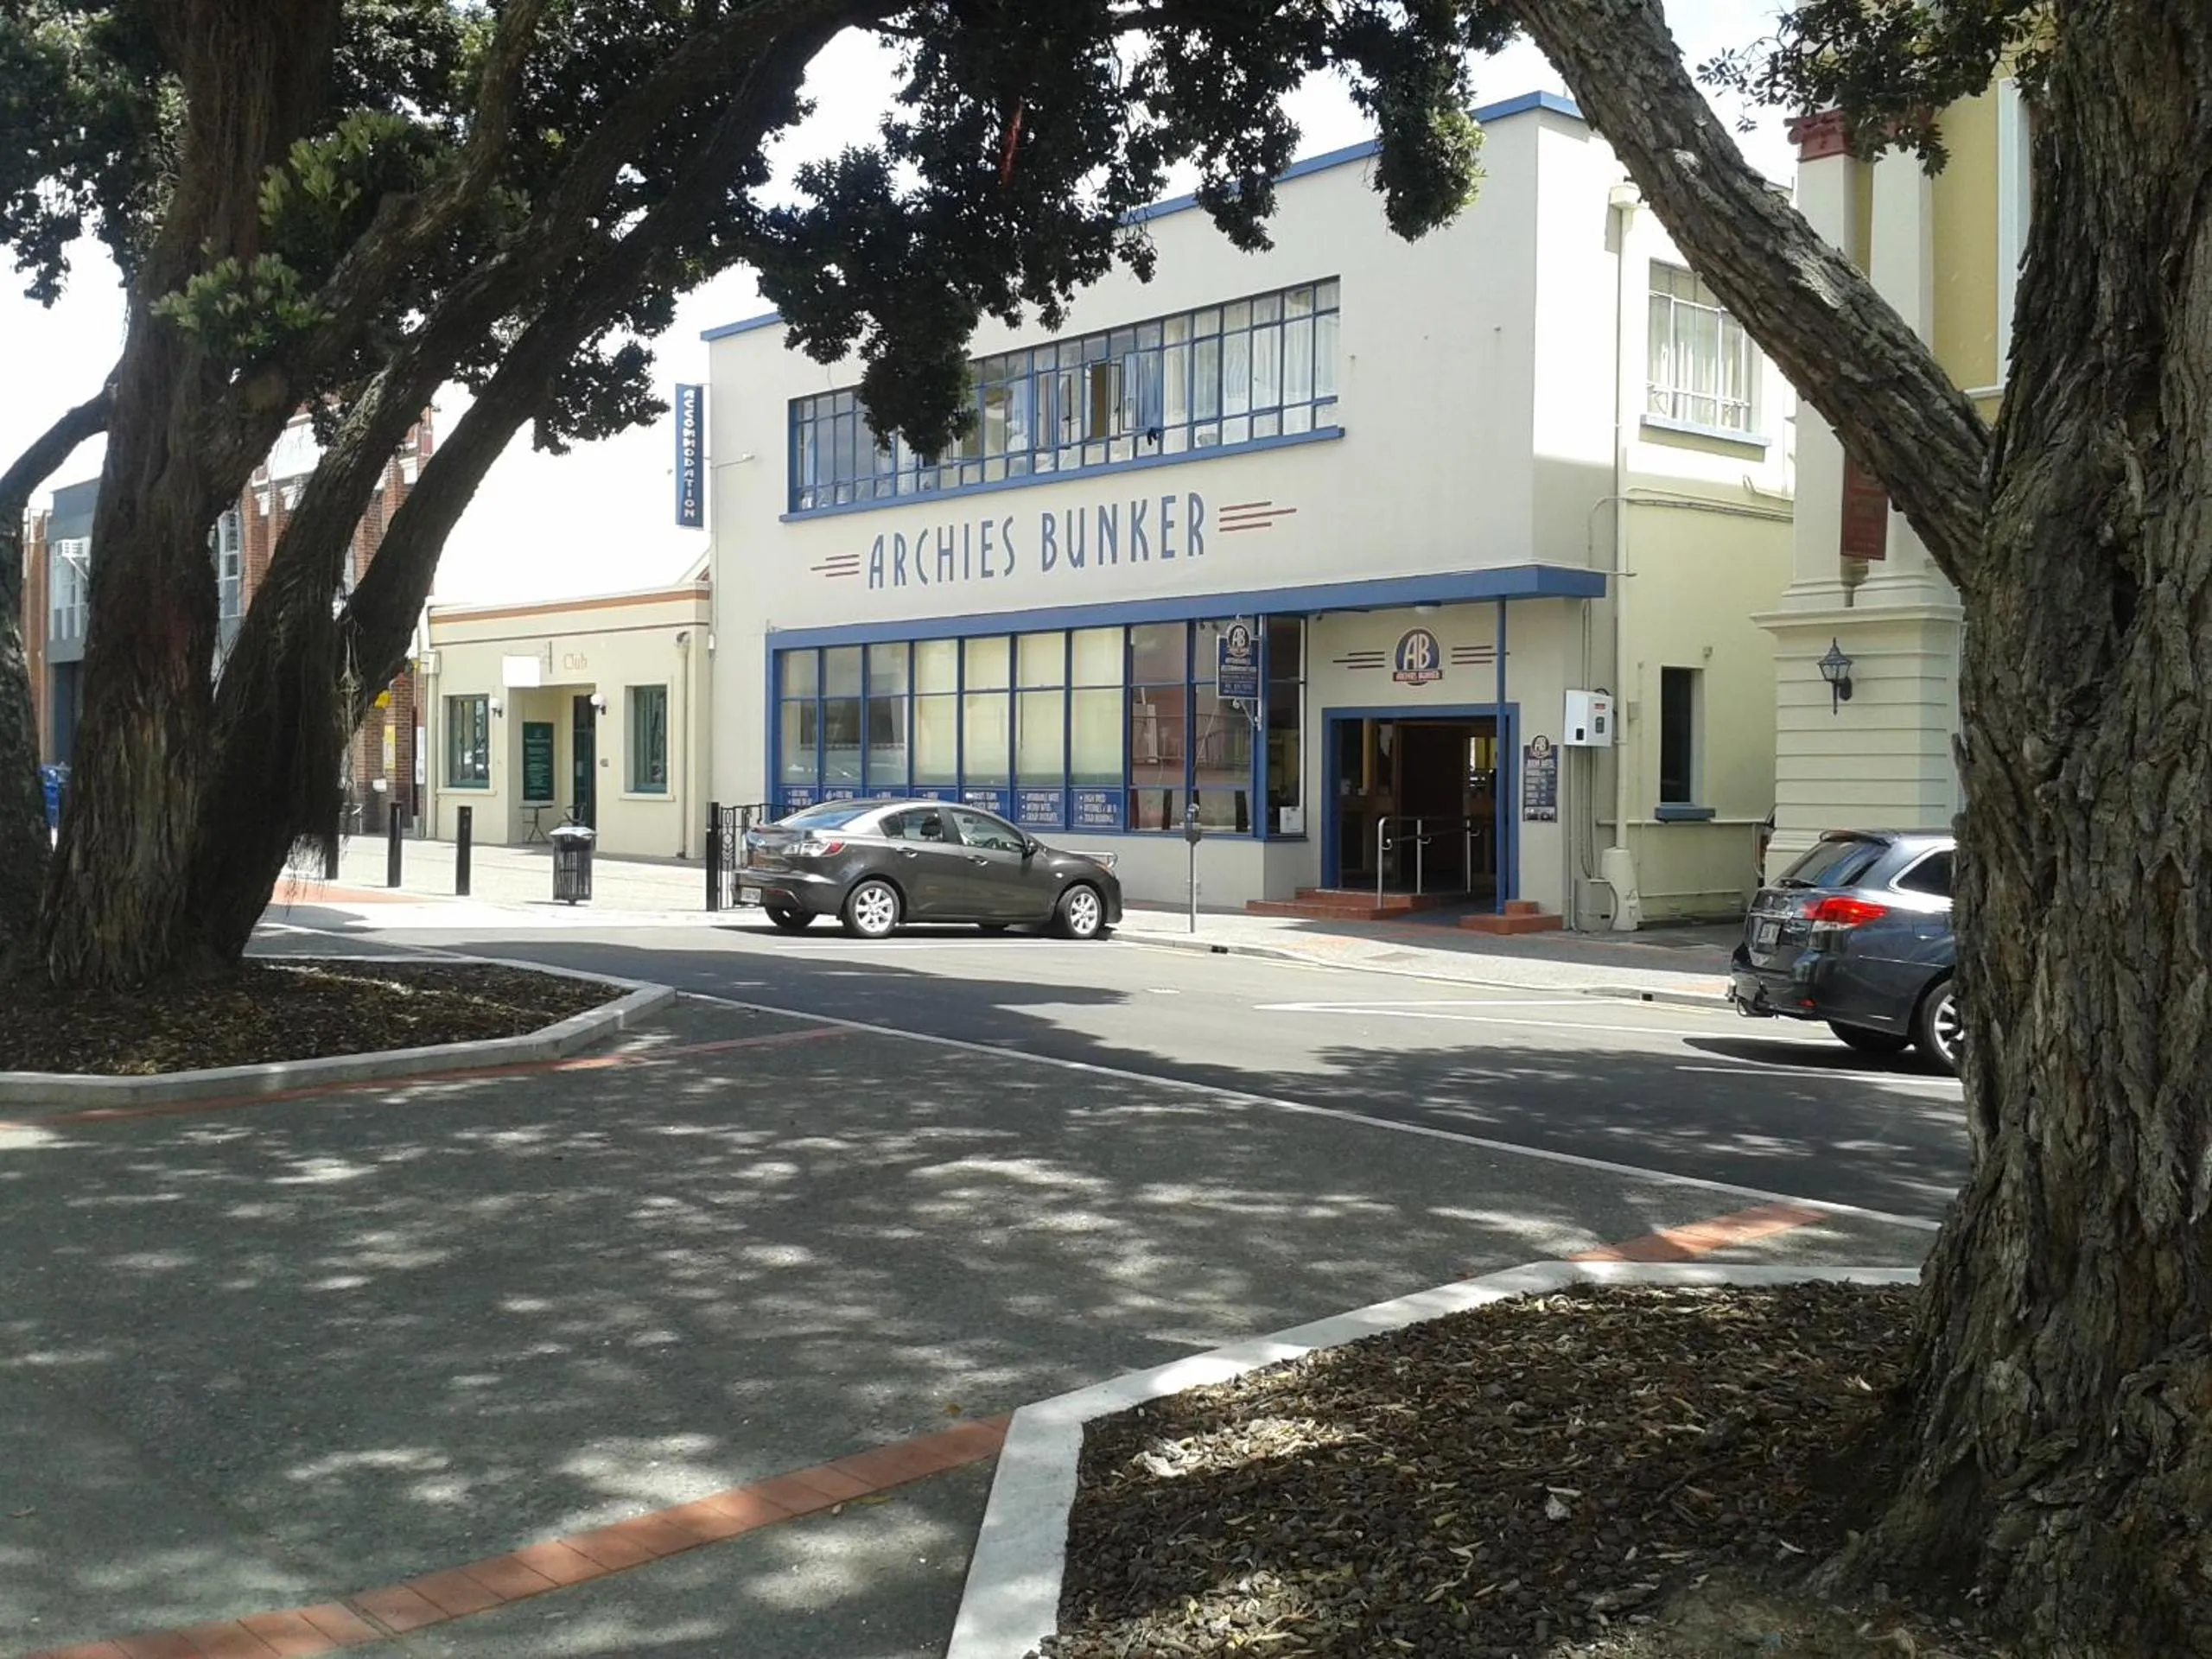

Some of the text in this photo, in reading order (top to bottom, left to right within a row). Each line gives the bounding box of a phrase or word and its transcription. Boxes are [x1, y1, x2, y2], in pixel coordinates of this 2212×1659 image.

[683, 389, 696, 518] ACCOMMODATION
[868, 492, 1205, 589] ARCHIES BUNKER
[1231, 627, 1246, 648] AB
[1403, 633, 1431, 670] AB
